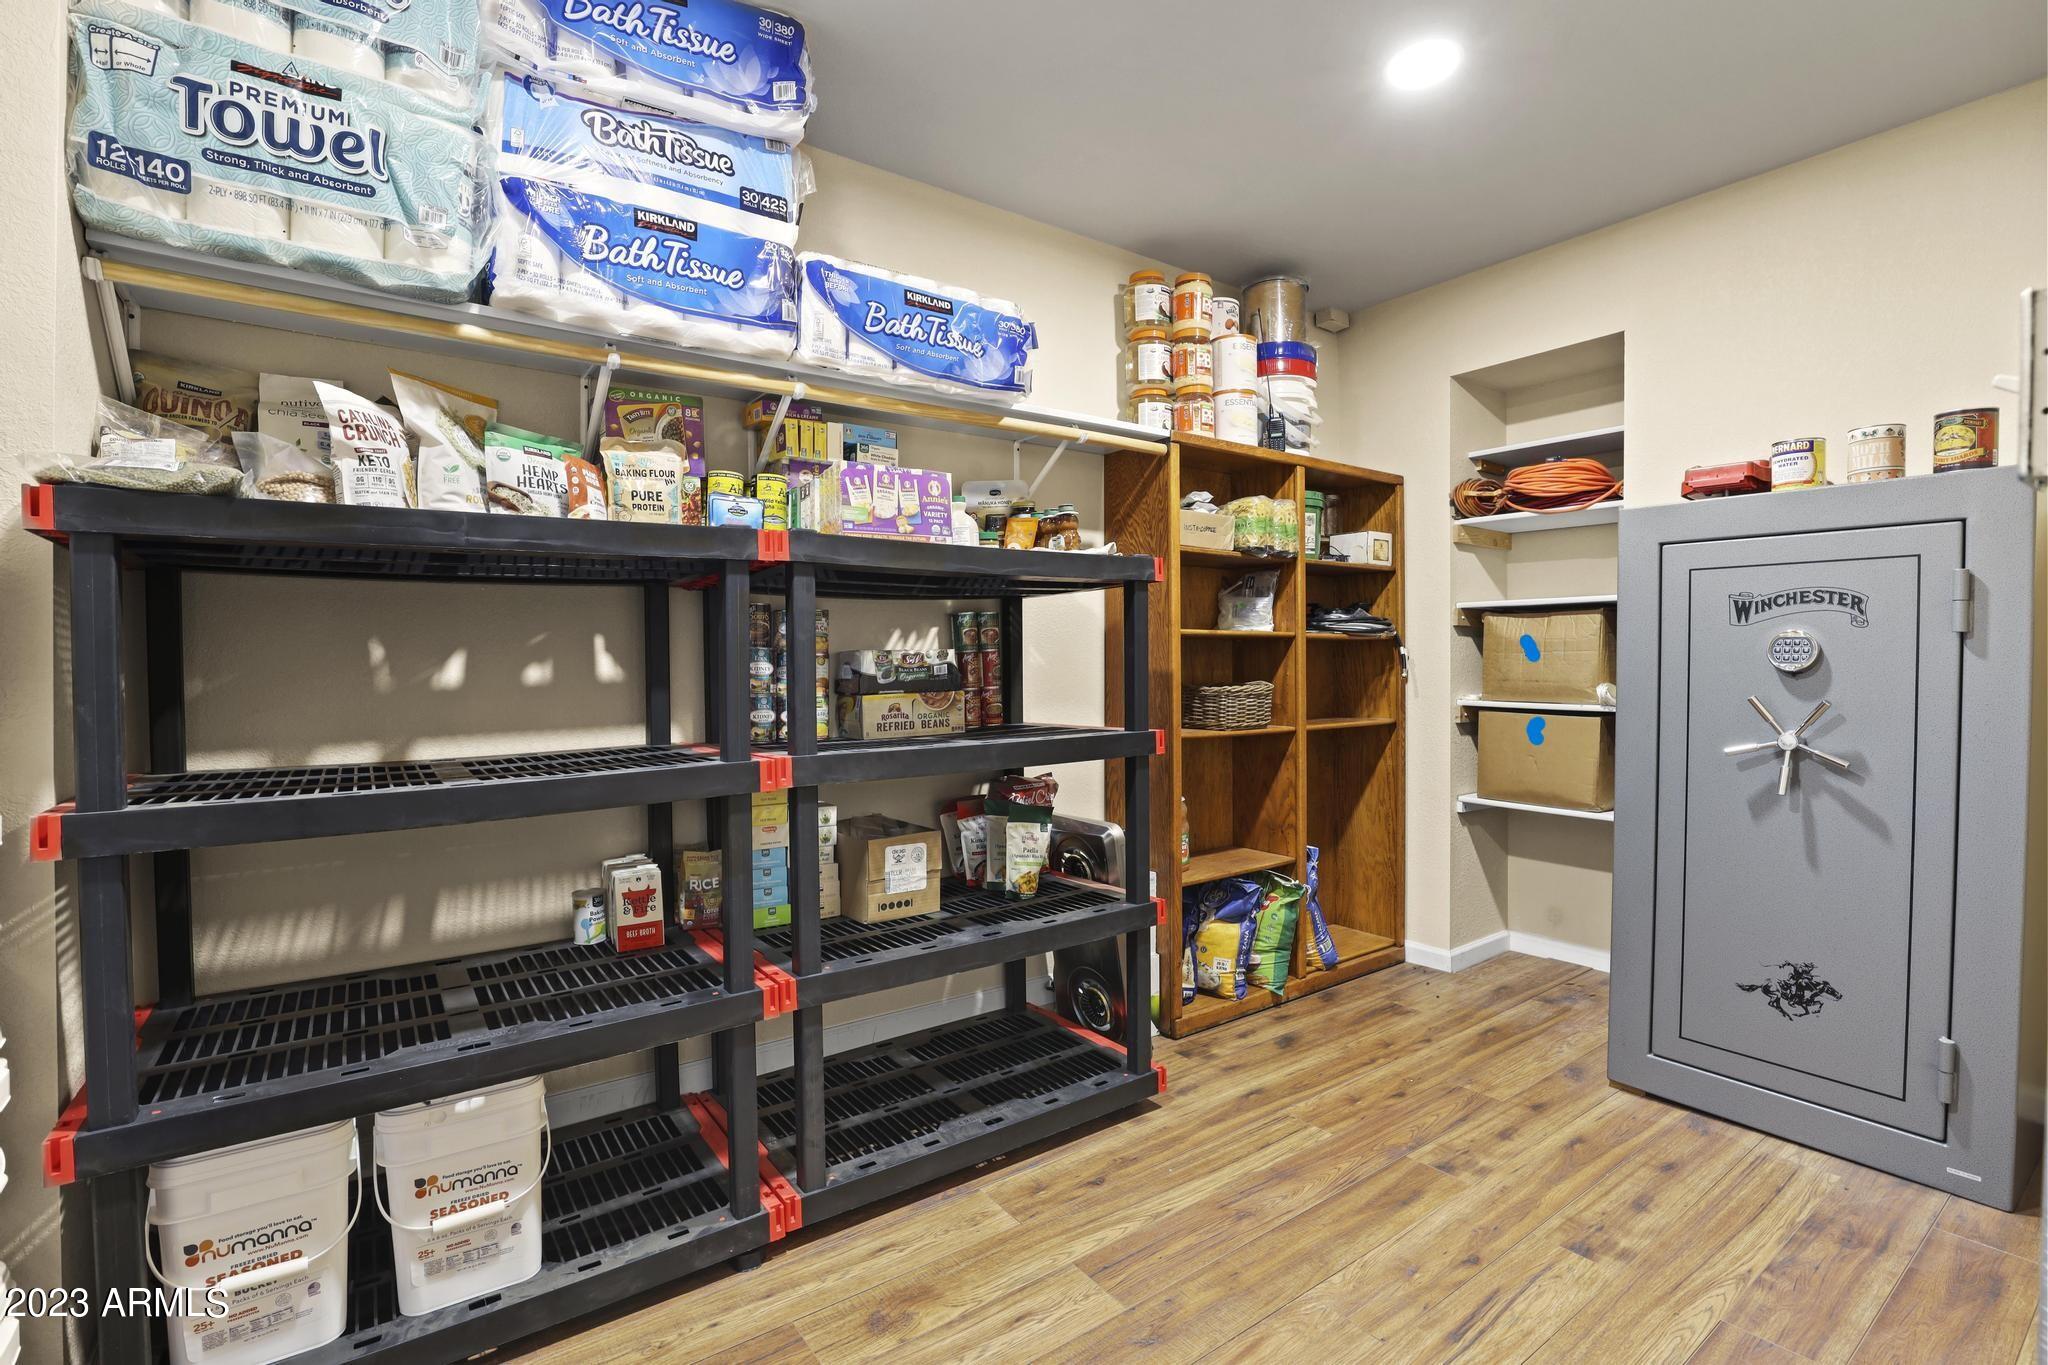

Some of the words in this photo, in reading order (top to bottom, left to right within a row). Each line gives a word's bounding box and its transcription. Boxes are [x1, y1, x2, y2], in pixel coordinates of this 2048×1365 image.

[650, 7, 737, 64] Tissue
[758, 16, 772, 29] 30
[774, 22, 795, 36] 380
[610, 34, 629, 48] Soft
[631, 44, 648, 54] and
[651, 48, 697, 68] Absorbent
[169, 74, 387, 180] Towel
[580, 109, 663, 155] Bath
[653, 127, 736, 176] Tissue
[96, 156, 127, 171] ROLLS
[97, 139, 127, 163] 12
[134, 154, 185, 182] 140
[205, 150, 251, 169] Strong,
[254, 159, 286, 176] Thick
[288, 169, 309, 182] and
[312, 175, 373, 196] Absorbent
[683, 168, 725, 186] Absorbency
[208, 185, 228, 197] 2-PLY
[742, 190, 759, 203] 30
[760, 196, 788, 213] 425
[636, 210, 696, 234] KIRKLAND
[582, 224, 665, 271] Bath
[662, 240, 745, 289] Tissue
[626, 273, 645, 284] Soft
[647, 278, 663, 288] and
[665, 281, 708, 296] Absorbent
[906, 291, 951, 311] KIRKLAND
[864, 301, 928, 343] Bath
[924, 315, 985, 359] Tissue
[896, 343, 912, 353] Soft
[913, 347, 926, 356] and
[927, 349, 961, 363] Absorbent
[629, 391, 681, 402] ORGANIC
[142, 386, 251, 430] QUINOA
[268, 408, 298, 417] chia
[301, 412, 329, 420] see
[338, 409, 394, 430] CATALINA
[342, 424, 401, 448] CRUNCH
[357, 454, 391, 468] KETO
[522, 464, 559, 482] HEMP
[615, 468, 648, 478] BAKING
[649, 469, 676, 479] FLOUR
[516, 475, 568, 494] HEARTS
[465, 494, 484, 505] ROL
[631, 490, 664, 502] PURE
[921, 496, 949, 505] Annie's
[632, 503, 665, 512] PROTEIN
[1732, 589, 1865, 624] WINCHESTER
[876, 720, 915, 732] REFRIED
[921, 718, 951, 729] BEANS
[881, 711, 910, 721] Rosarita
[917, 711, 950, 720] ORGANIC
[689, 877, 720, 891] RICE
[622, 905, 631, 915] &
[626, 930, 638, 938] BEEF
[639, 927, 656, 937] BROTH
[428, 1164, 519, 1197] numanna
[455, 1168, 473, 1177] storage
[429, 1190, 510, 1220] SEASONED
[450, 1196, 471, 1205] FREEZE
[472, 1191, 490, 1199] DRIED
[218, 1235, 234, 1244] Food
[234, 1228, 257, 1239] storage
[257, 1223, 273, 1233] you'll
[273, 1219, 286, 1228] love
[201, 1220, 313, 1264] numanna
[247, 1234, 309, 1256] www.NuManna.com
[230, 1258, 256, 1270] FREEZE
[256, 1251, 278, 1261] DRIED
[417, 1248, 436, 1259] 25+
[252, 1292, 260, 1301] of
[265, 1280, 293, 1294] Servings
[293, 1275, 309, 1285] Each
[238, 1306, 258, 1317] ADDED
[193, 1320, 215, 1333] 25+
